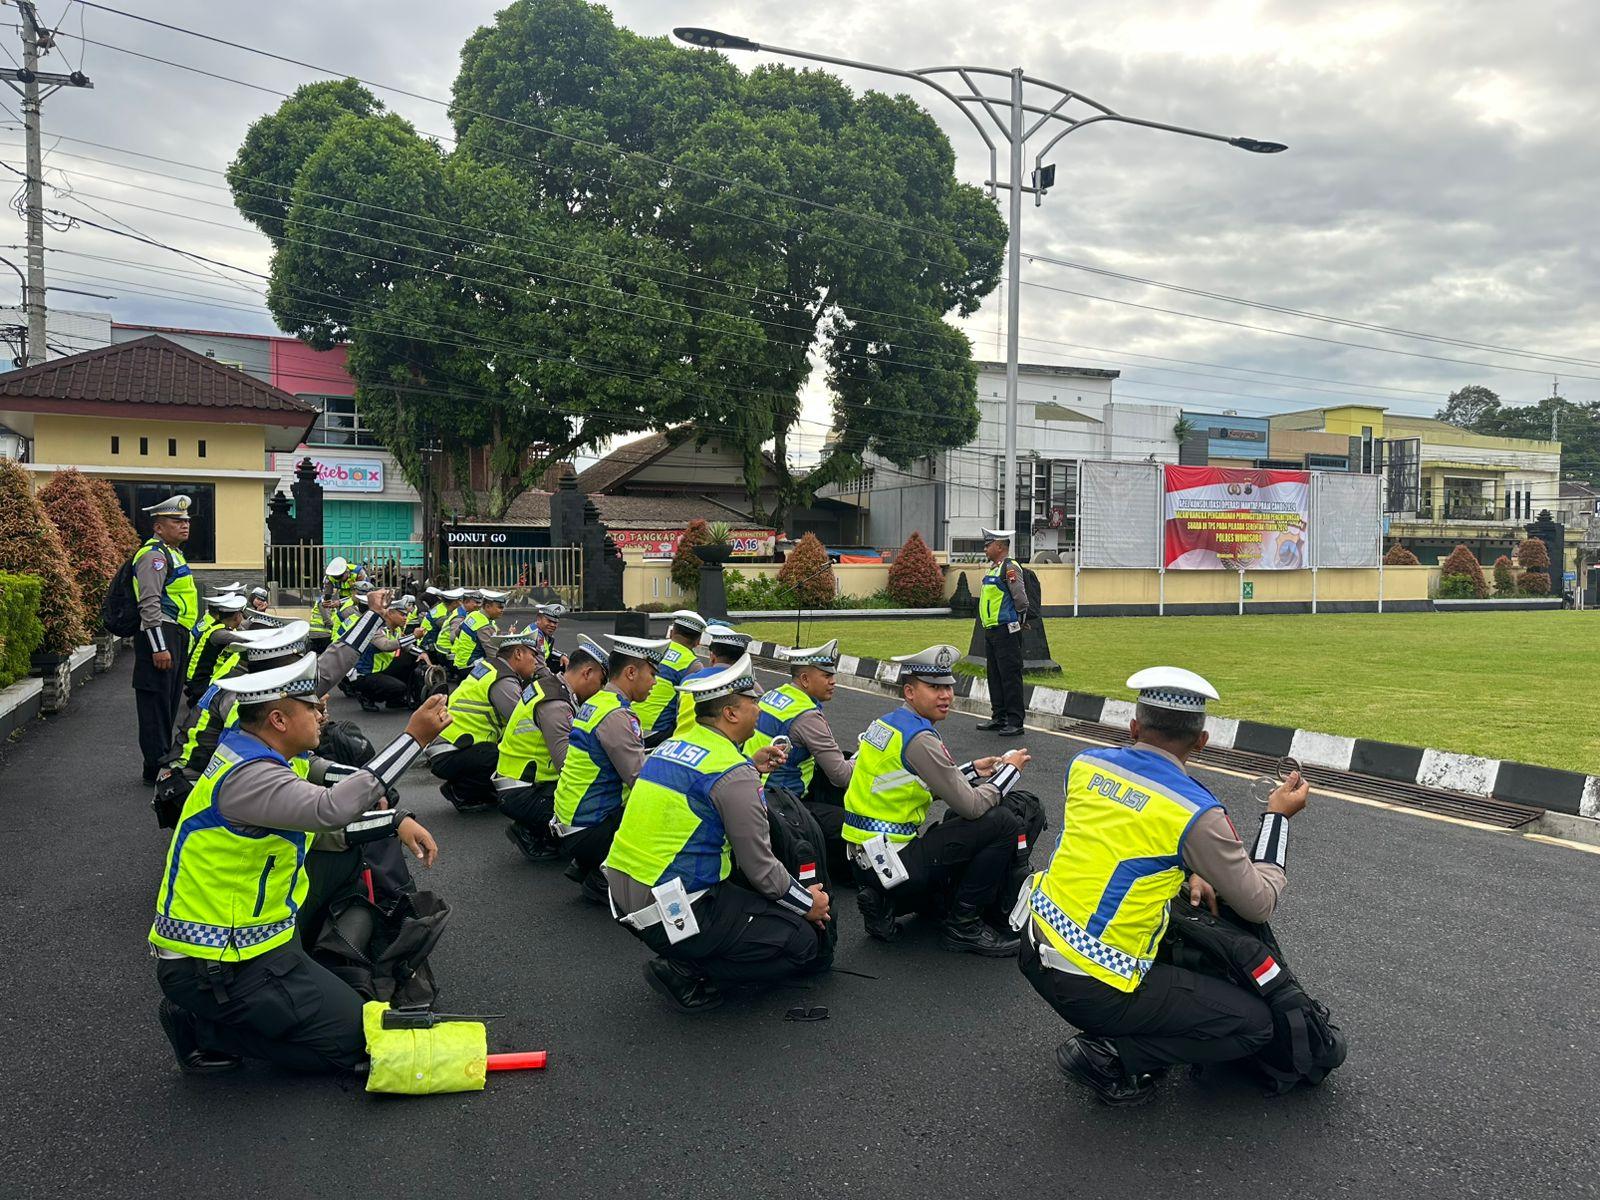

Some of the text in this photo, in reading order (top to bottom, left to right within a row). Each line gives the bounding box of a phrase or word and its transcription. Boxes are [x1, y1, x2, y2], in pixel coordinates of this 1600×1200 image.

[448, 533, 507, 542] DONUT GO
[630, 533, 676, 541] TANGKAR
[745, 539, 758, 550] 16
[654, 740, 709, 766] POLISI
[1087, 773, 1151, 812] POLISI
